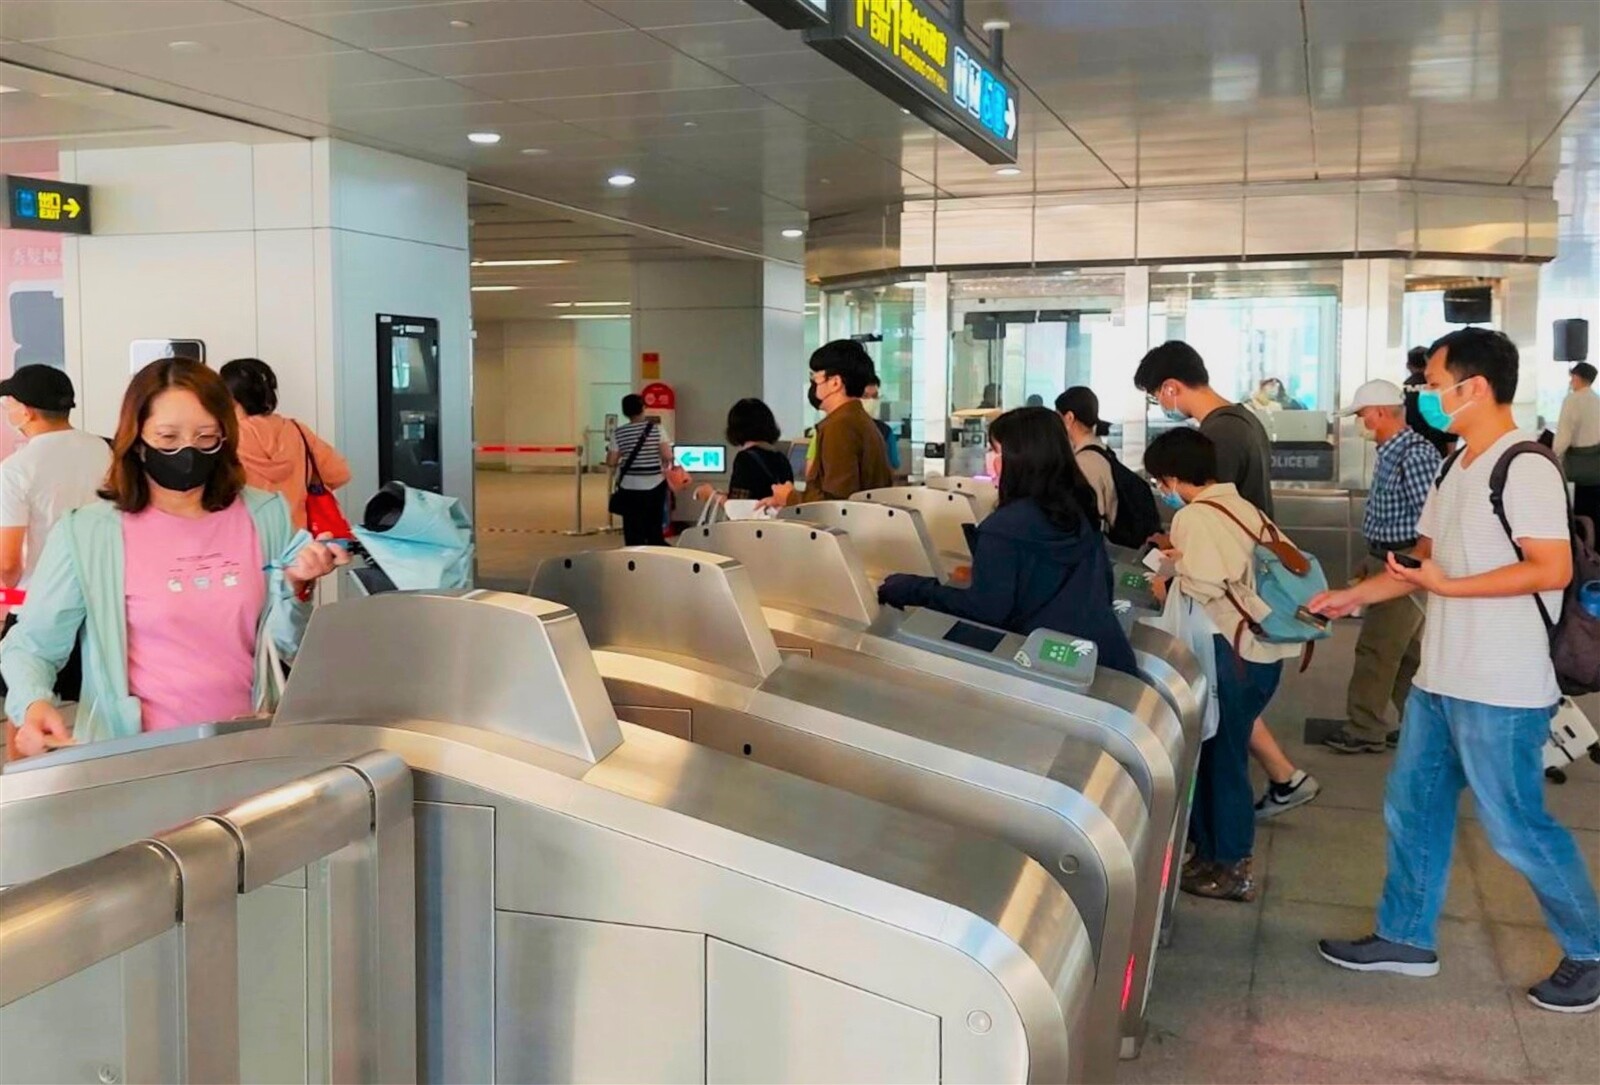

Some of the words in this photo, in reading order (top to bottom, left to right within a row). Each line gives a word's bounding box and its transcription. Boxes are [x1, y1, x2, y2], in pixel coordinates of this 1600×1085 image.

[870, 12, 890, 48] EXIT
[37, 191, 61, 209] 出口
[39, 207, 60, 220] EXIT
[1270, 455, 1305, 468] OLICE
